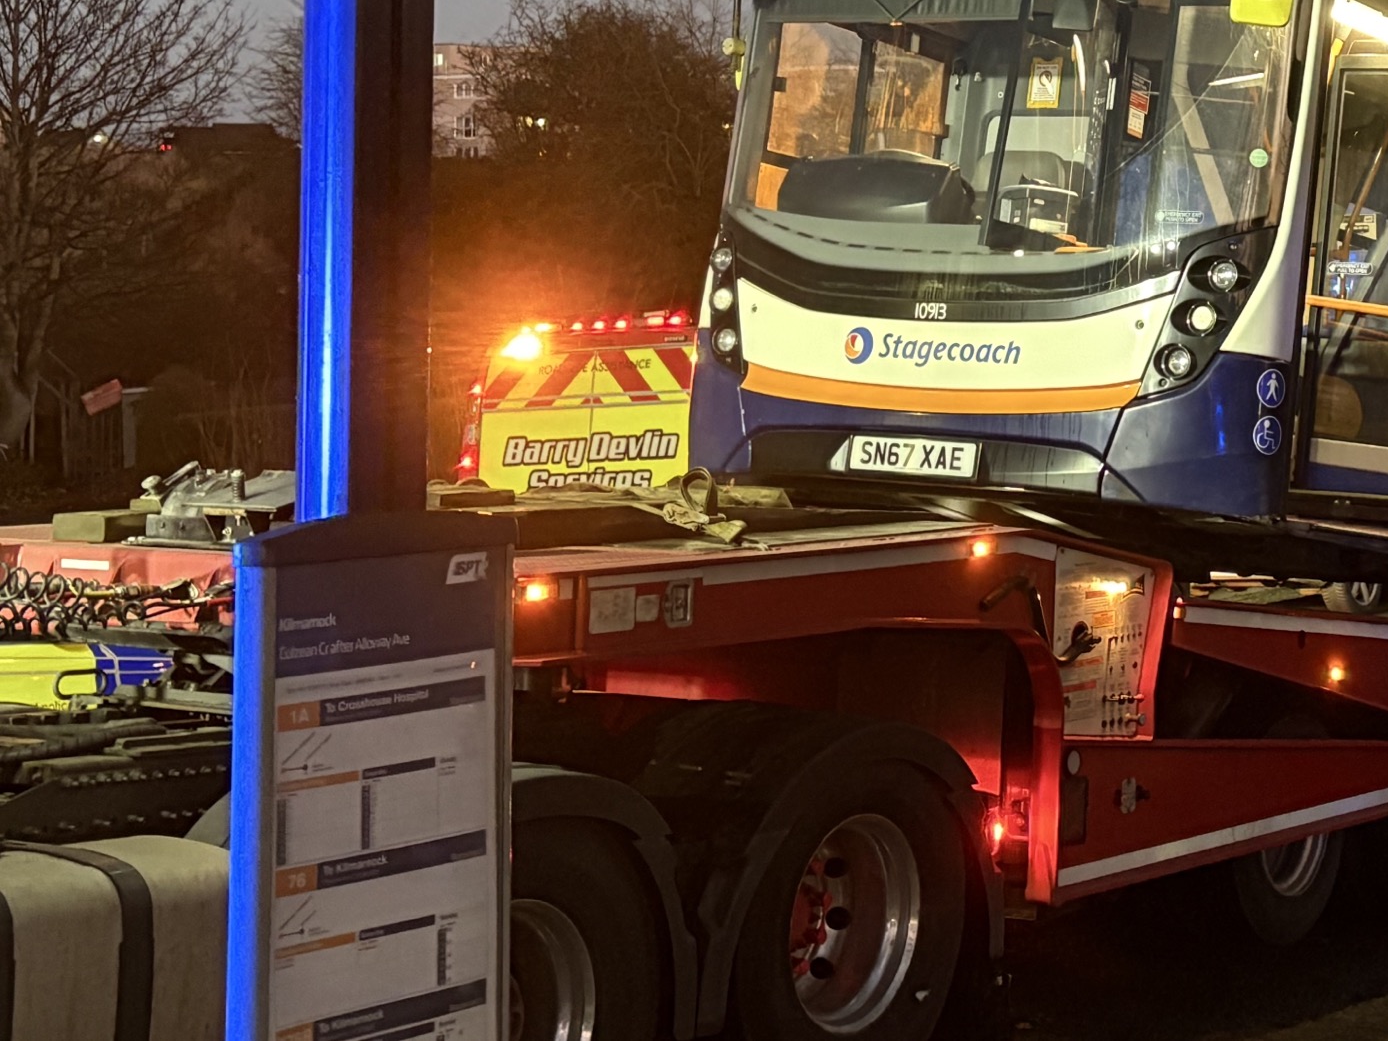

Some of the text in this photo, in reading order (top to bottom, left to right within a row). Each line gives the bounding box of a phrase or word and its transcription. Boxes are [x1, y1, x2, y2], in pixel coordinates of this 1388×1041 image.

[914, 302, 947, 320] 10913
[878, 332, 1021, 368] Stagecoach
[502, 428, 680, 468] Barry Devlin
[860, 440, 964, 471] SN67 XAE
[289, 708, 309, 725] 1A
